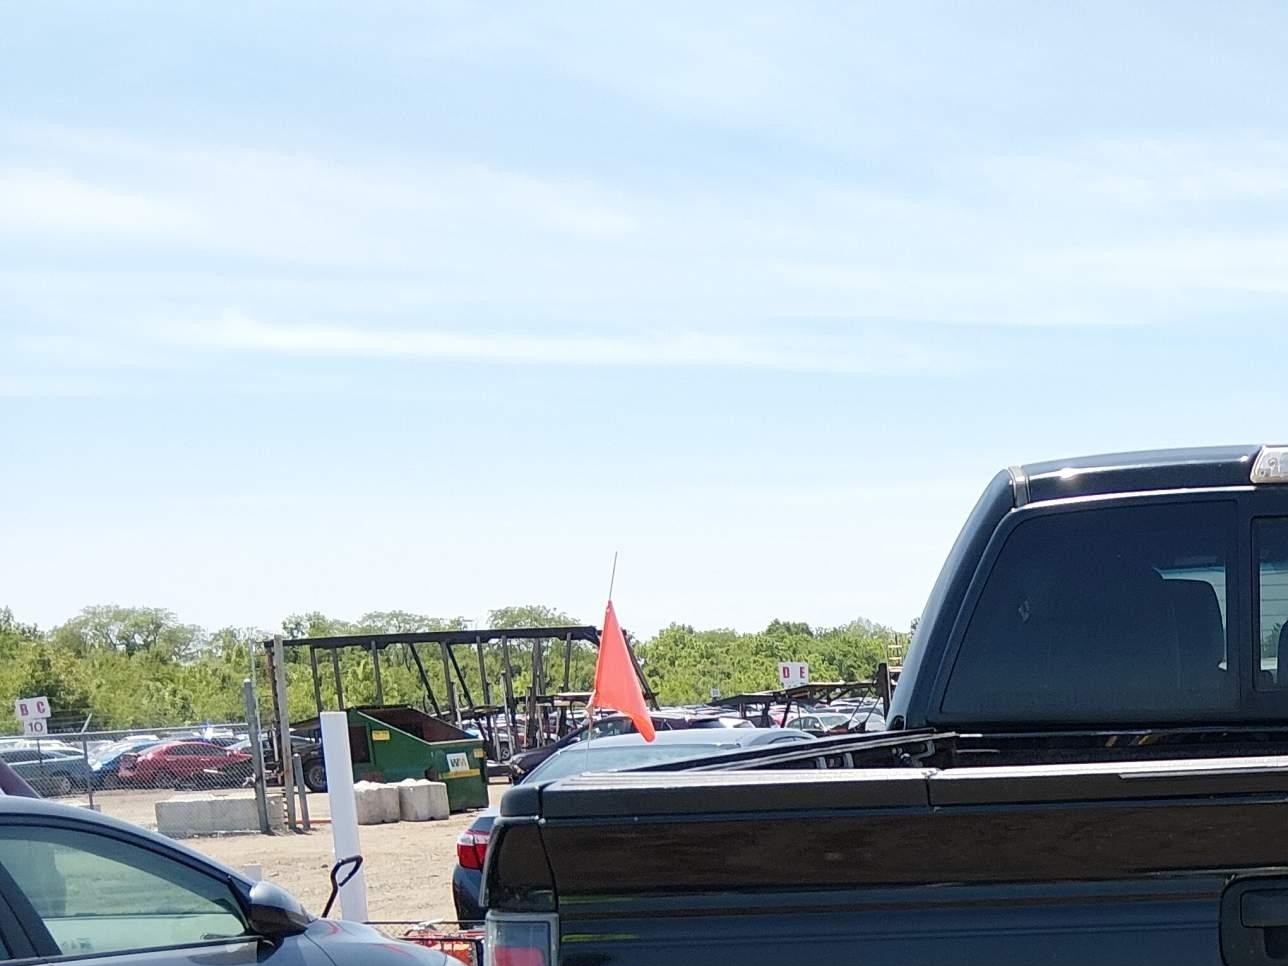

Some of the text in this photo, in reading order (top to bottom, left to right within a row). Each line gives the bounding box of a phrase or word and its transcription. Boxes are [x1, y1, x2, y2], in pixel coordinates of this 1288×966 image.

[782, 666, 806, 678] D E
[19, 701, 46, 716] B C
[28, 721, 44, 732] 10
